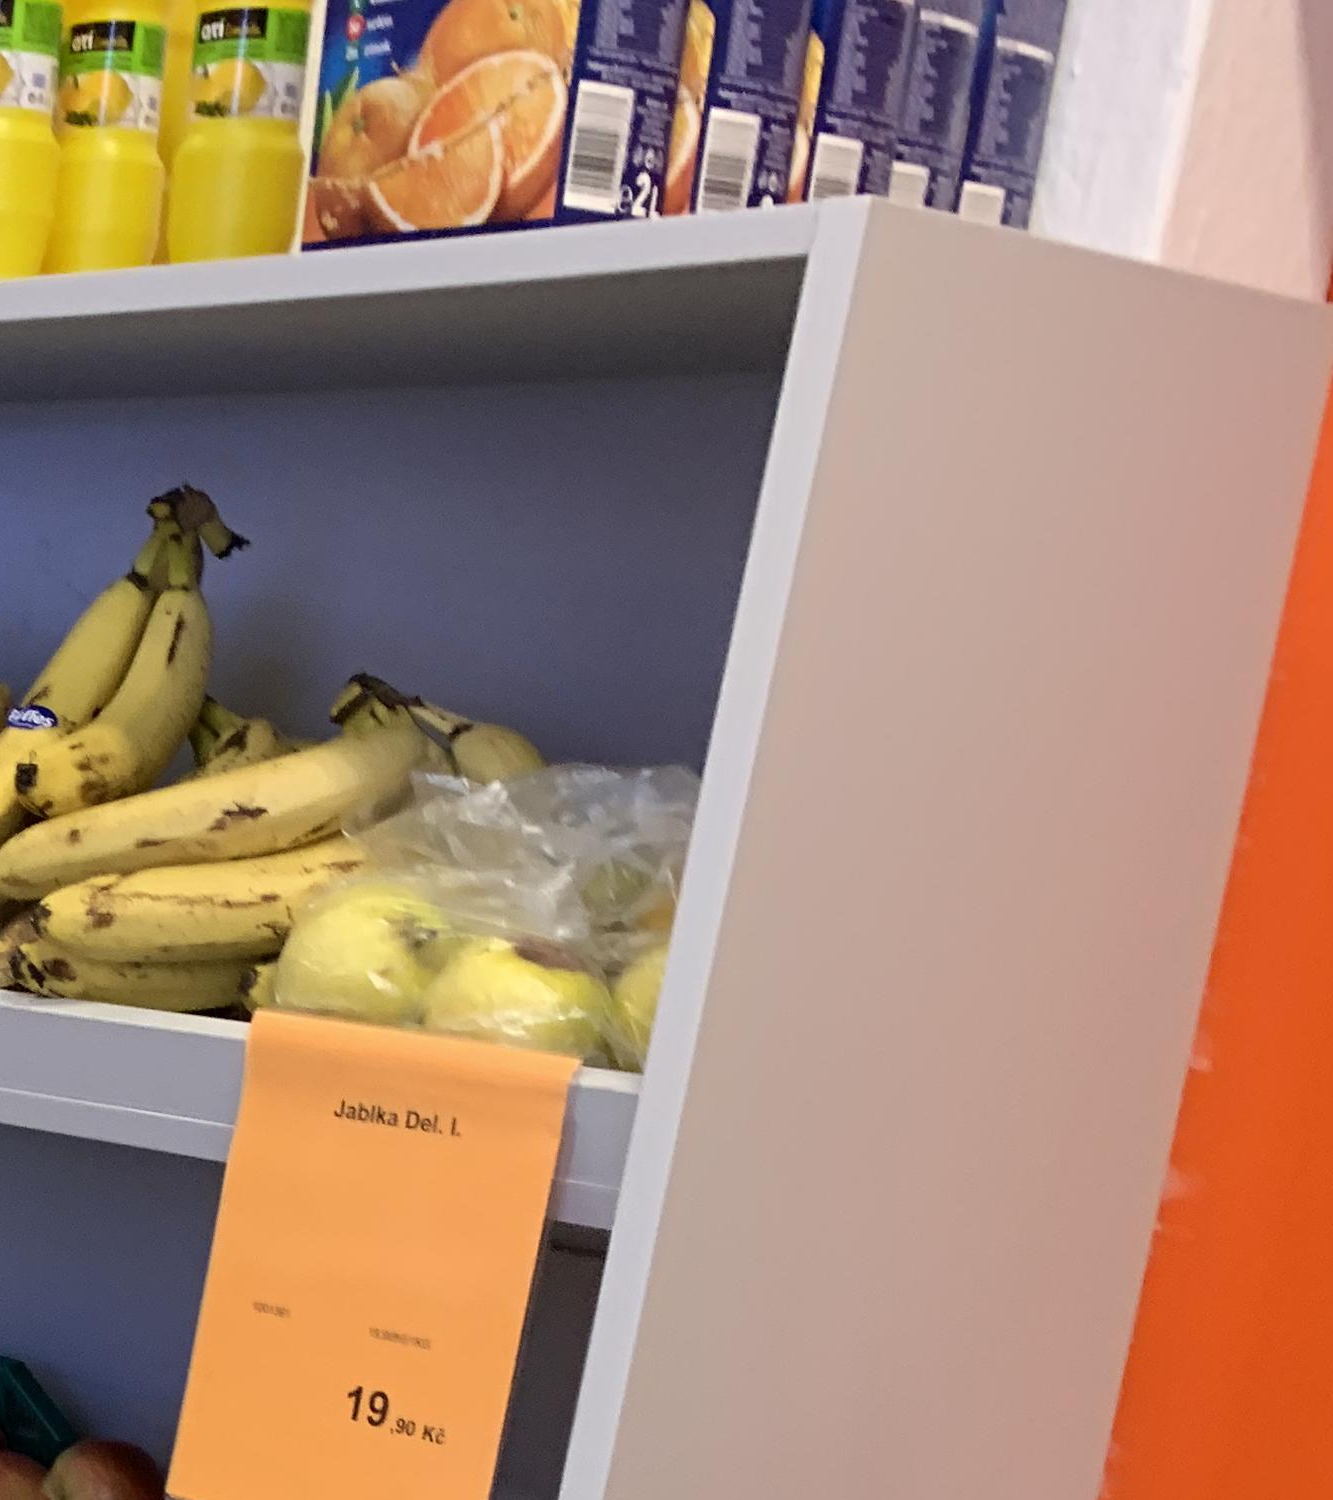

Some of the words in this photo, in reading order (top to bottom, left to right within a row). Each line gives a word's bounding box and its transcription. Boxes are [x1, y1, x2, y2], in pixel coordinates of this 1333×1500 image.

[334, 1099, 399, 1127] Jablka
[405, 1111, 443, 1135] Del.
[421, 1424, 446, 1446] Kč
